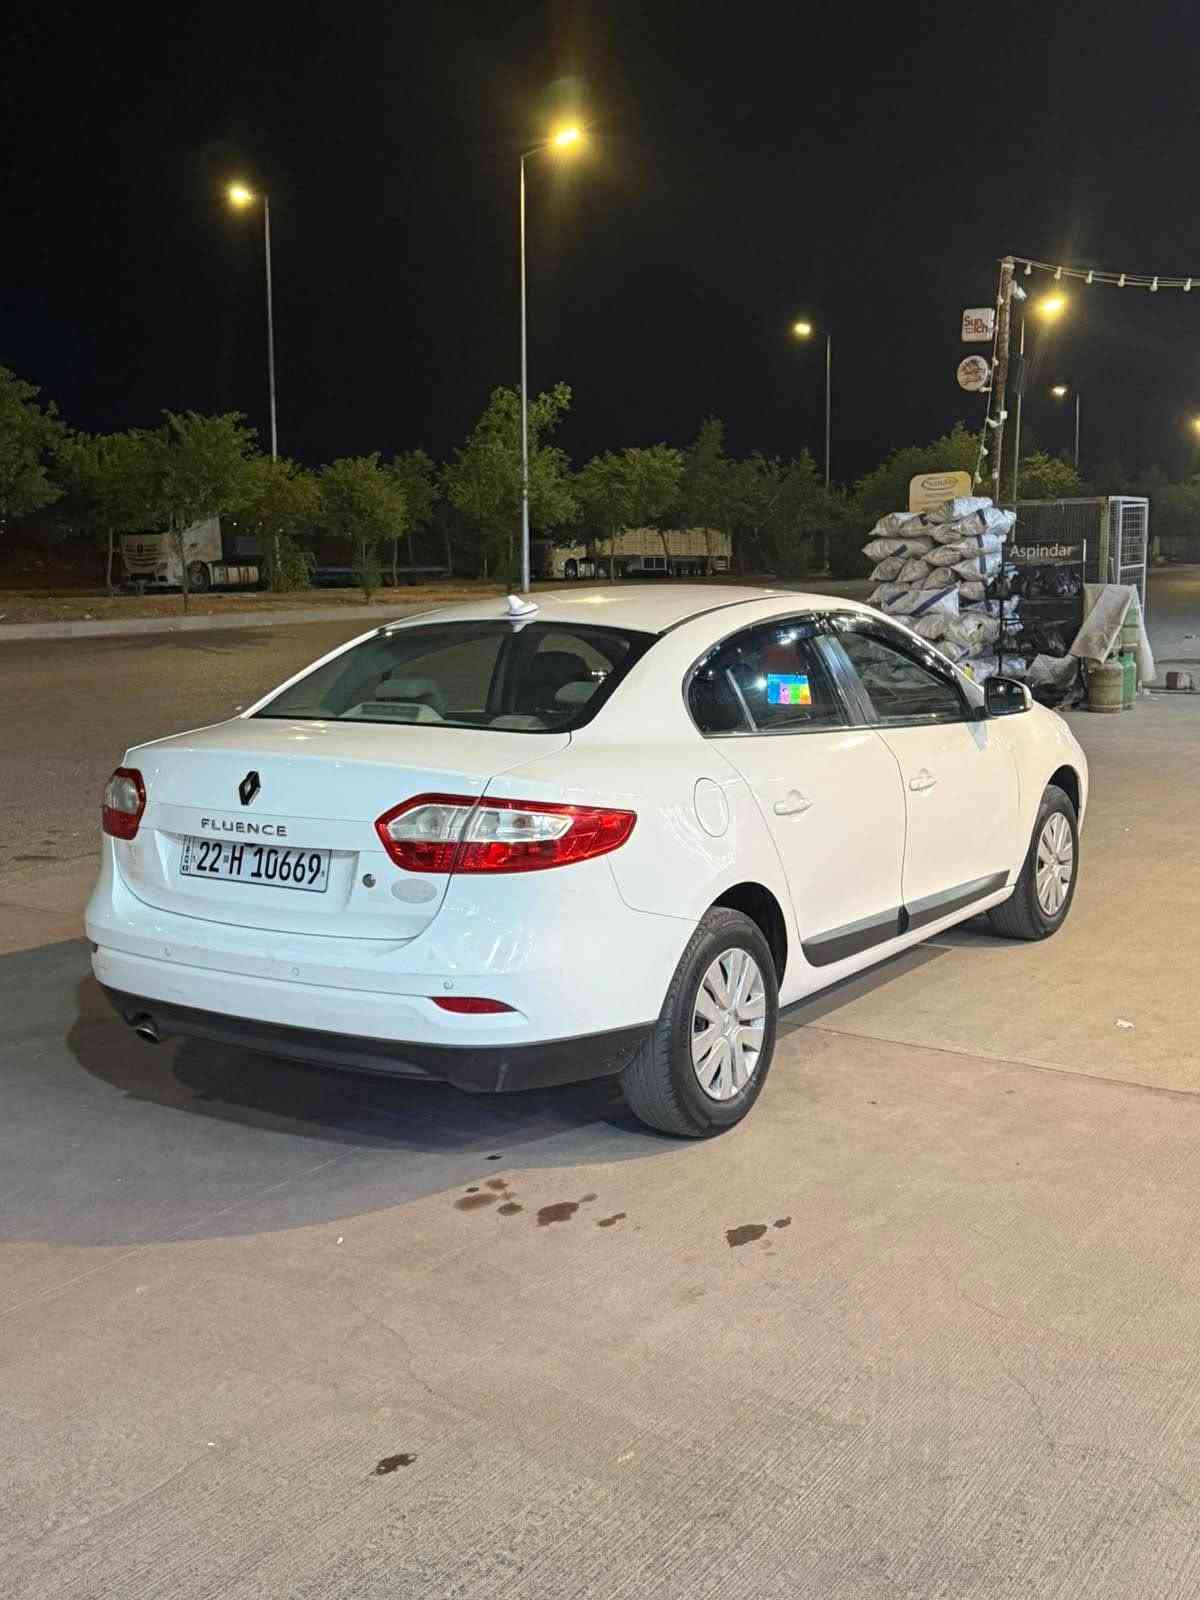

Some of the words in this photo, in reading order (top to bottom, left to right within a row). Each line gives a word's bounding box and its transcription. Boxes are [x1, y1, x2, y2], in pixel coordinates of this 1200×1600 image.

[1009, 543, 1073, 560] Aspindar
[200, 818, 288, 837] FLUENCE
[196, 841, 222, 873] 22
[229, 844, 244, 875] H
[250, 847, 322, 885] 10669
